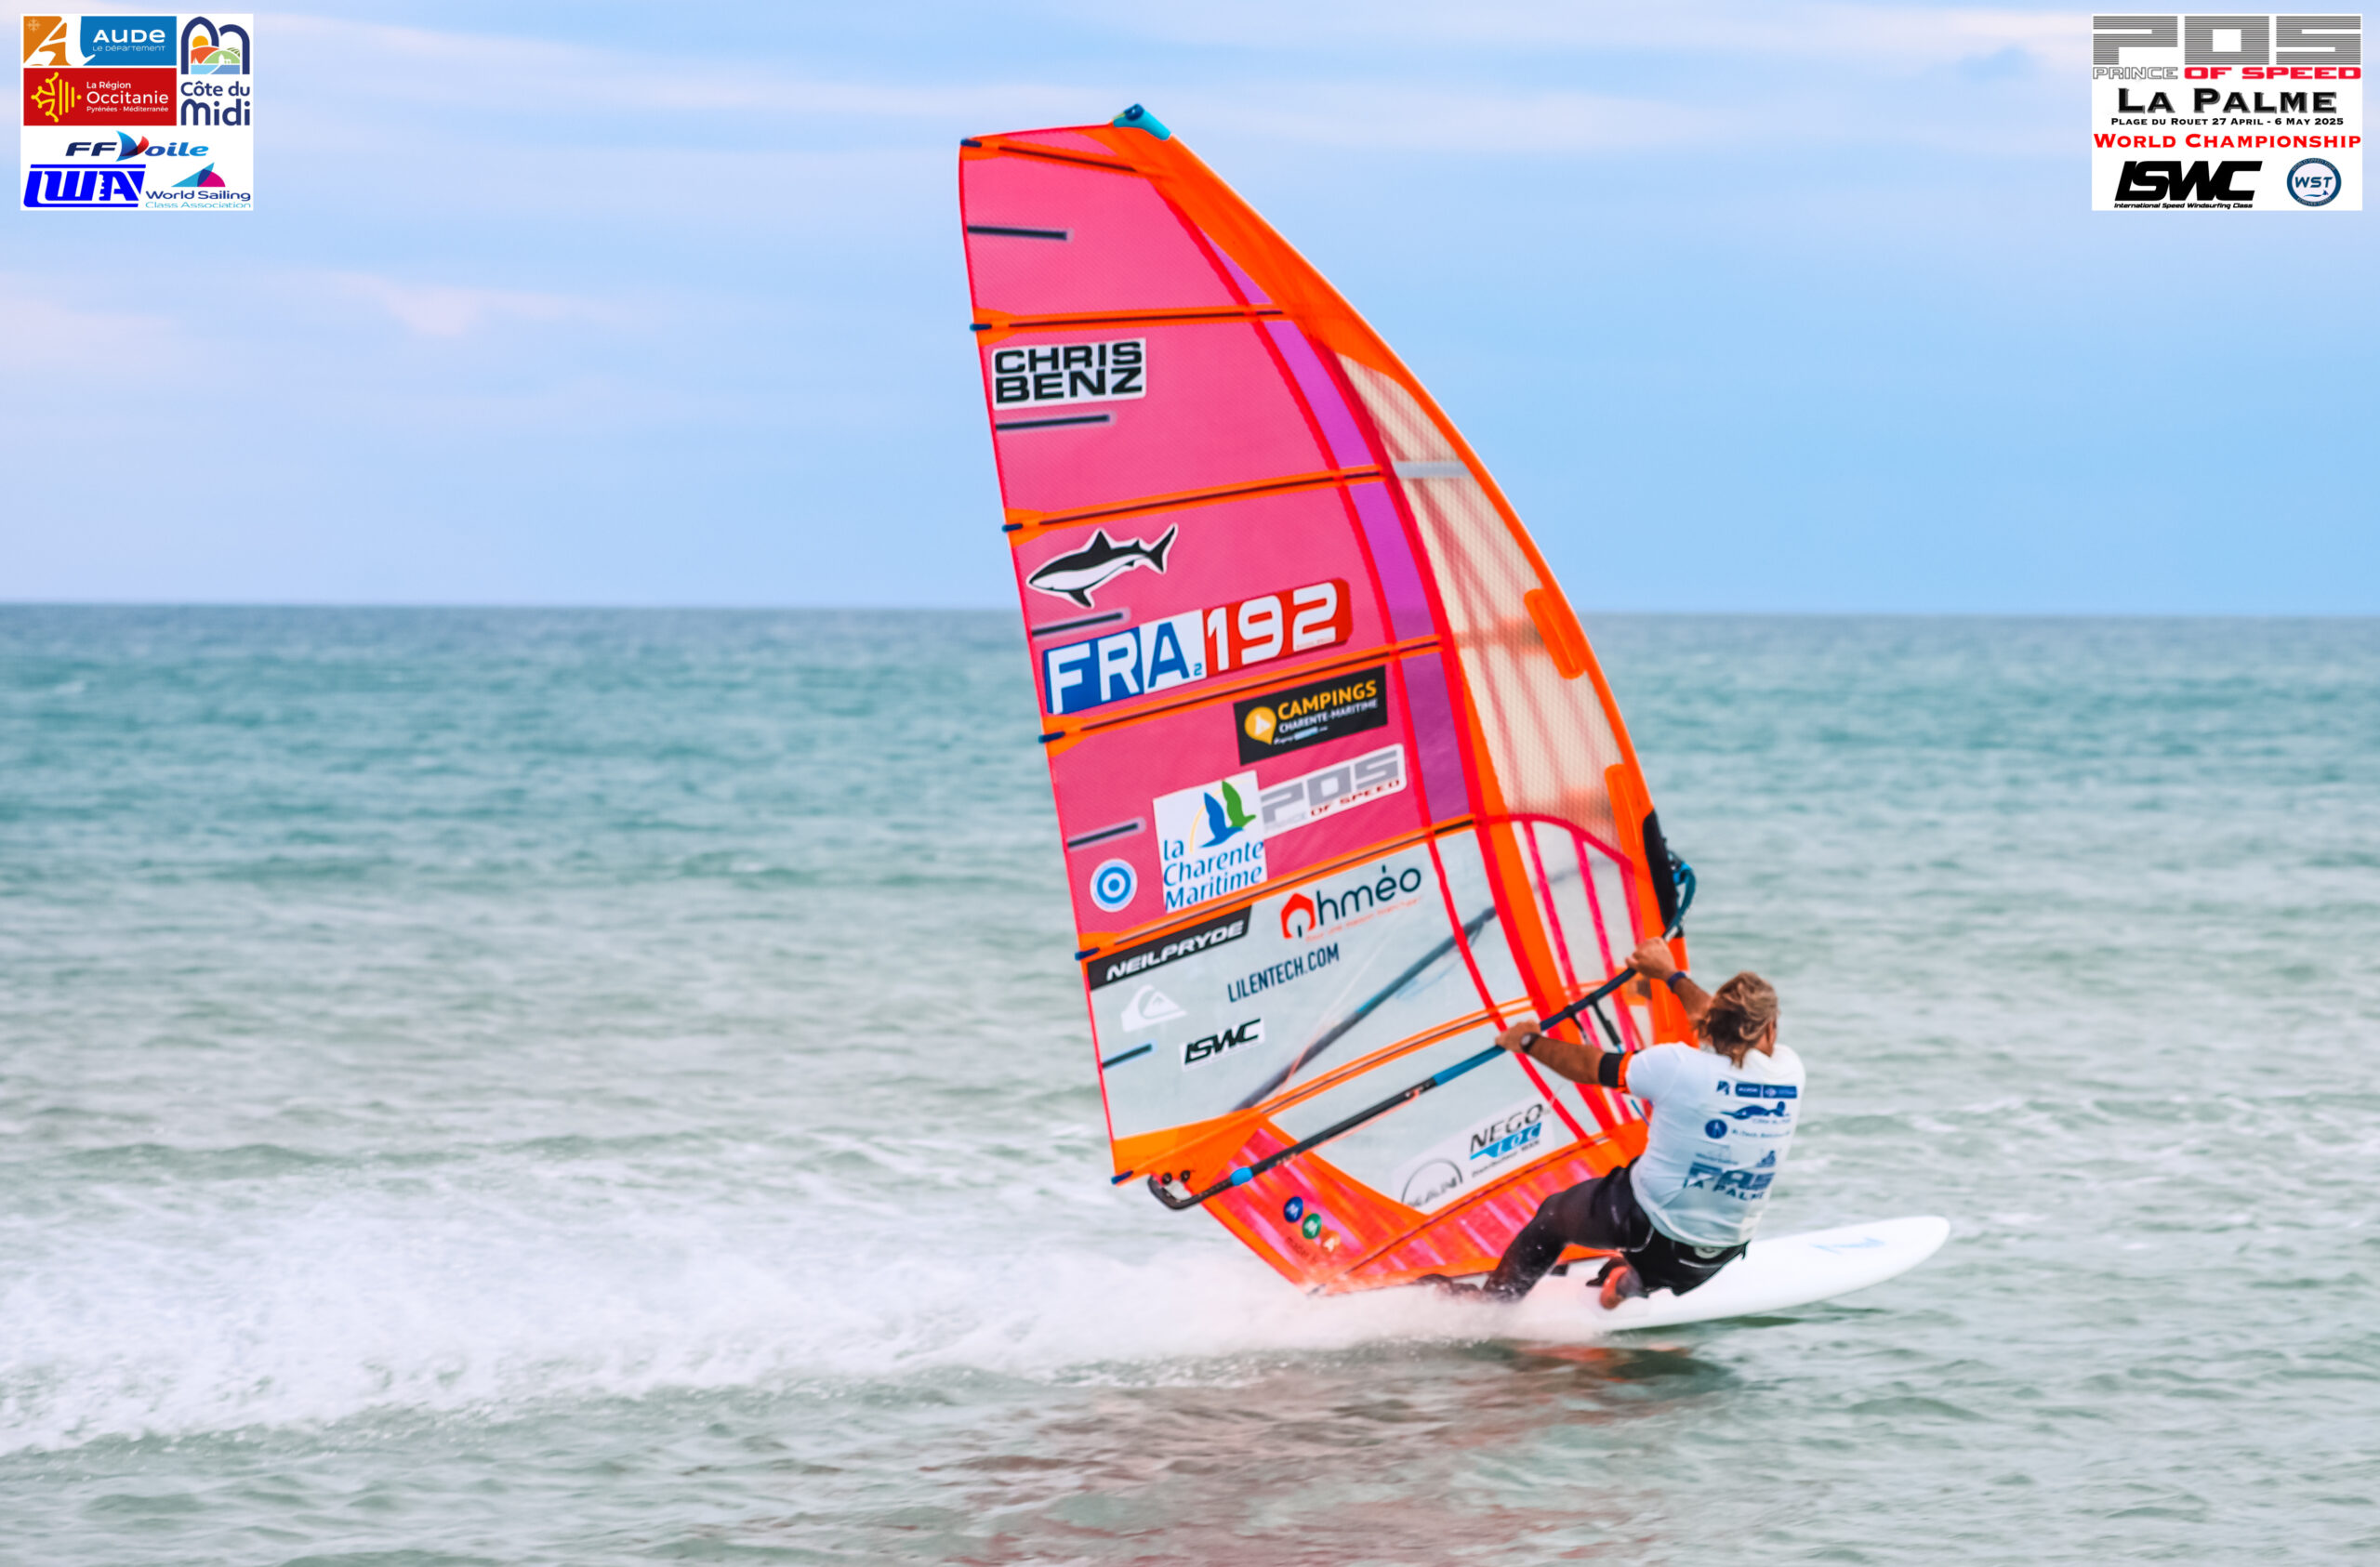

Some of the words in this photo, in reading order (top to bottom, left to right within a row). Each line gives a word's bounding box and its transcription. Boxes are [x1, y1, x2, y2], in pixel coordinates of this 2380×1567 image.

[995, 341, 1143, 374] CHRIS
[995, 366, 1143, 403] BENZ
[1048, 621, 1190, 715] FRA
[1208, 582, 1338, 671] 192
[1277, 679, 1377, 719] CAMPINGS
[1164, 840, 1184, 861] la
[1164, 841, 1264, 886] Charente
[1166, 866, 1262, 911] Maritime
[1106, 919, 1244, 981] NEILPRYDE
[1227, 942, 1340, 1003] LILENTECH.COM
[1184, 1018, 1261, 1065] ISWC
[1470, 1103, 1543, 1153] NEGO
